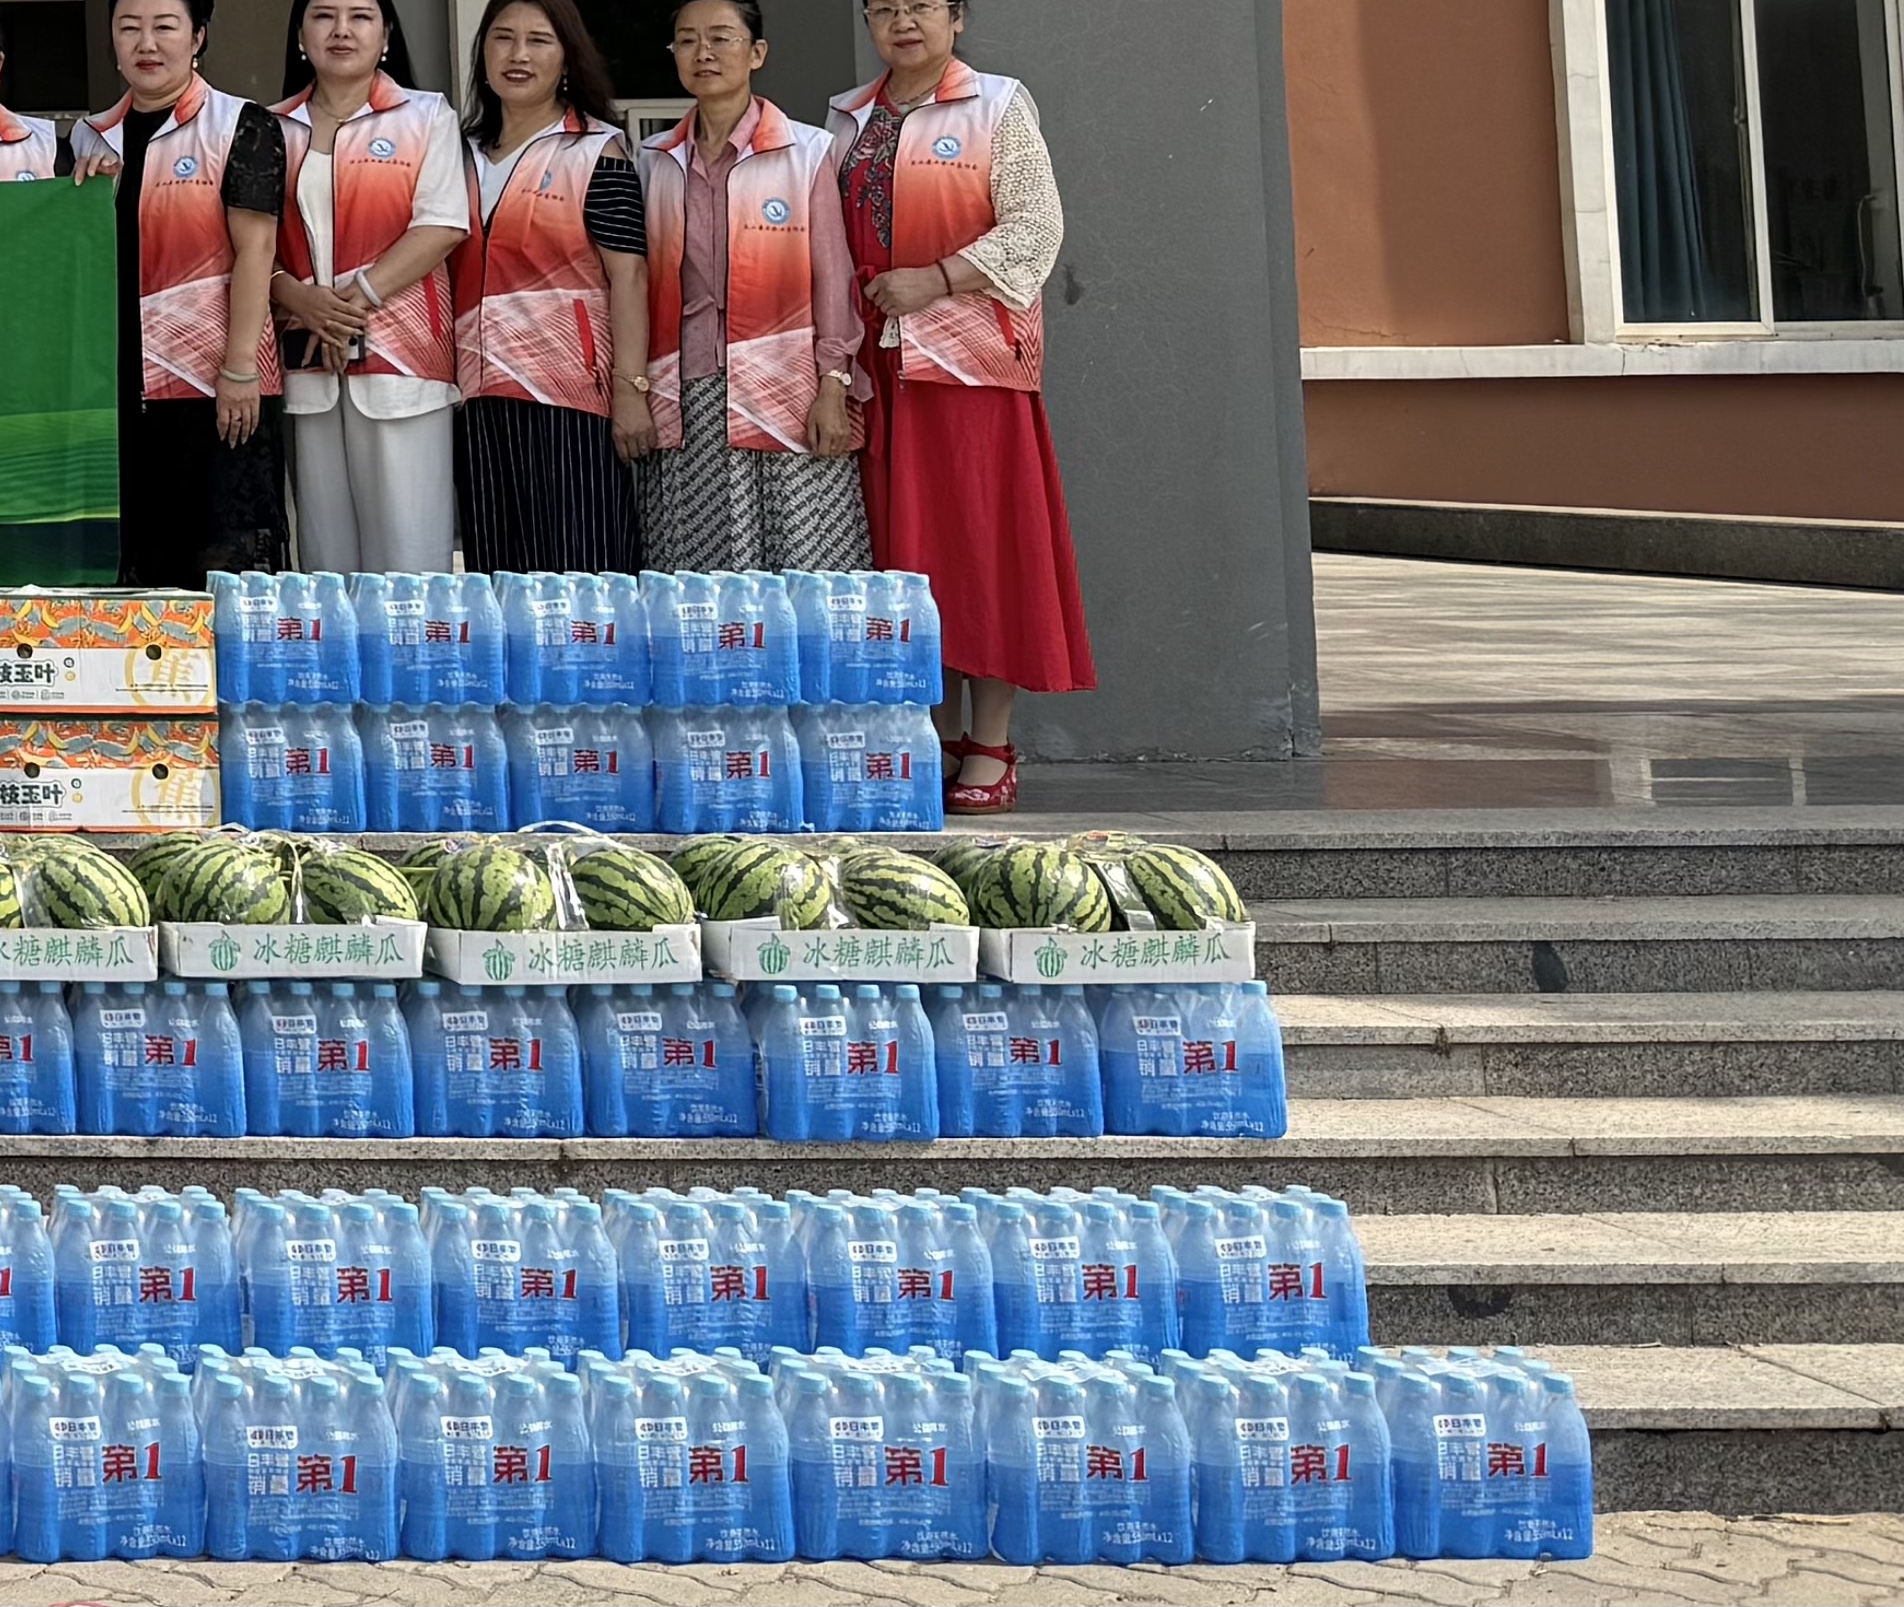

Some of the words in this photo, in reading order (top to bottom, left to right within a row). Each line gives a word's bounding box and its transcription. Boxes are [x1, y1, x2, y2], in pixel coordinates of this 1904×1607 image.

[253, 934, 404, 965] 冰糖麒麟瓜
[528, 936, 679, 971] 冰糖麒麟瓜
[803, 935, 955, 968] 冰糖麒麟瓜
[1080, 932, 1232, 970] 冰糖麒麟瓜
